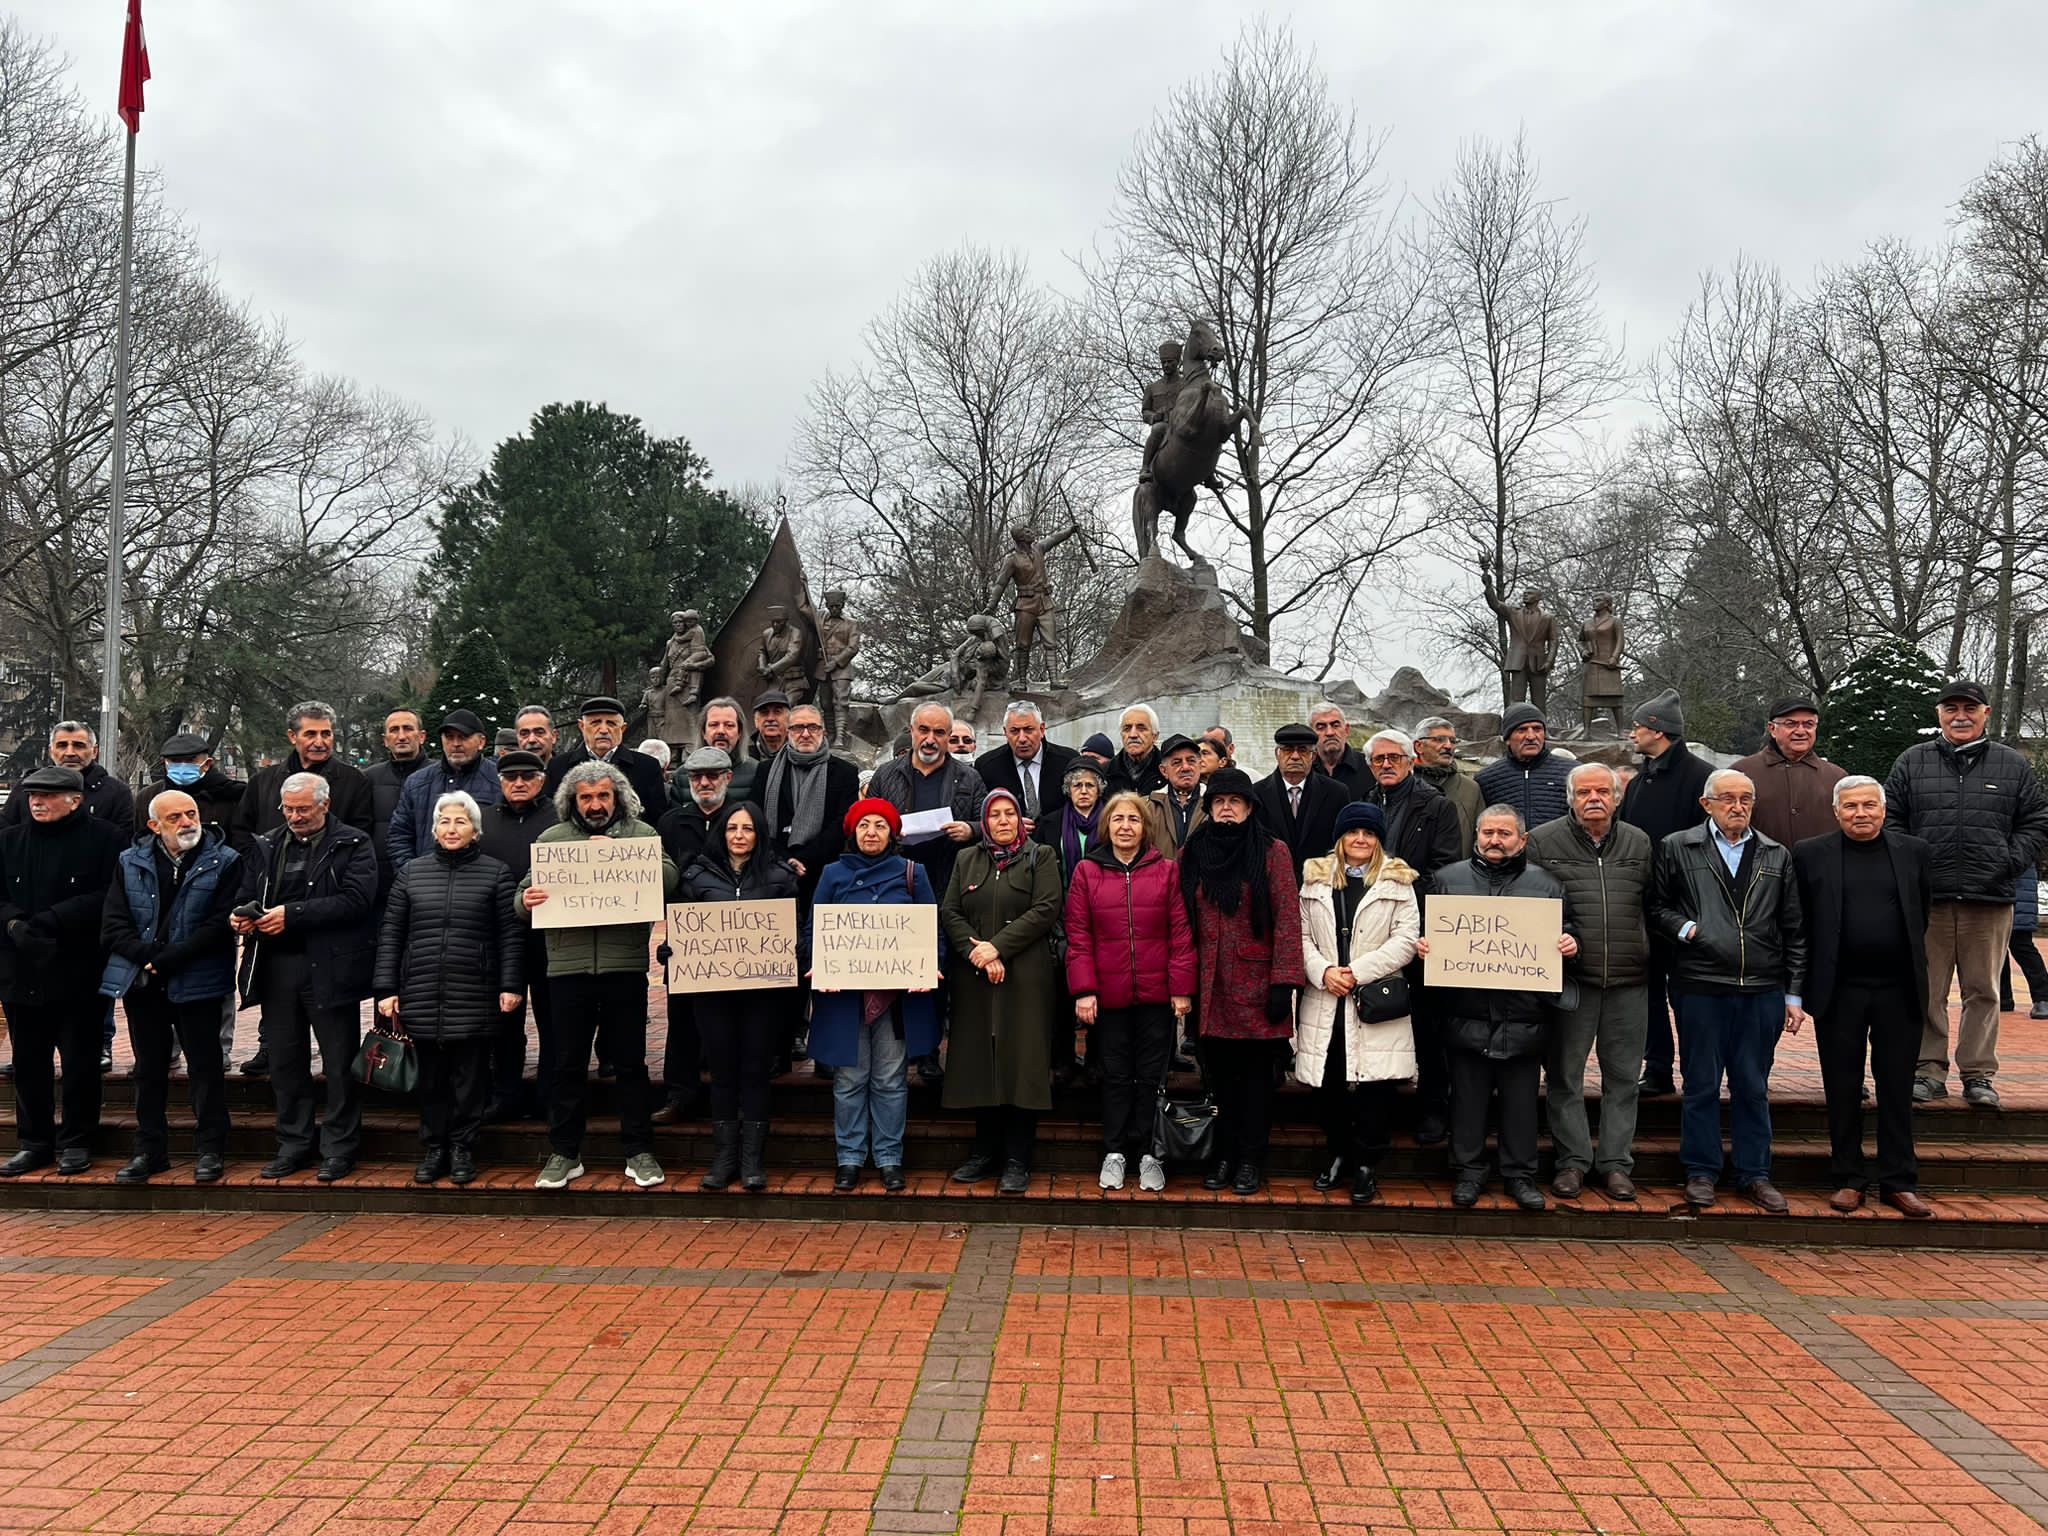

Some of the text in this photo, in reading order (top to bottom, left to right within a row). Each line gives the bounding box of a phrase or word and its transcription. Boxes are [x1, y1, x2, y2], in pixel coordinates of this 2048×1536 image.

[536, 843, 658, 864] EMEKLİ SADAKA
[593, 869, 657, 885] HAKKINI
[562, 891, 625, 909] İSTİYOR
[673, 906, 780, 934] KÖK HÜCRE
[820, 911, 915, 934] EMEKLİLİK
[1434, 913, 1517, 937] SABIR
[760, 934, 795, 956] KÖK
[1468, 939, 1538, 961] KARIN
[848, 958, 914, 976] BULMAK
[1443, 959, 1549, 980] DOYURMUYOR
